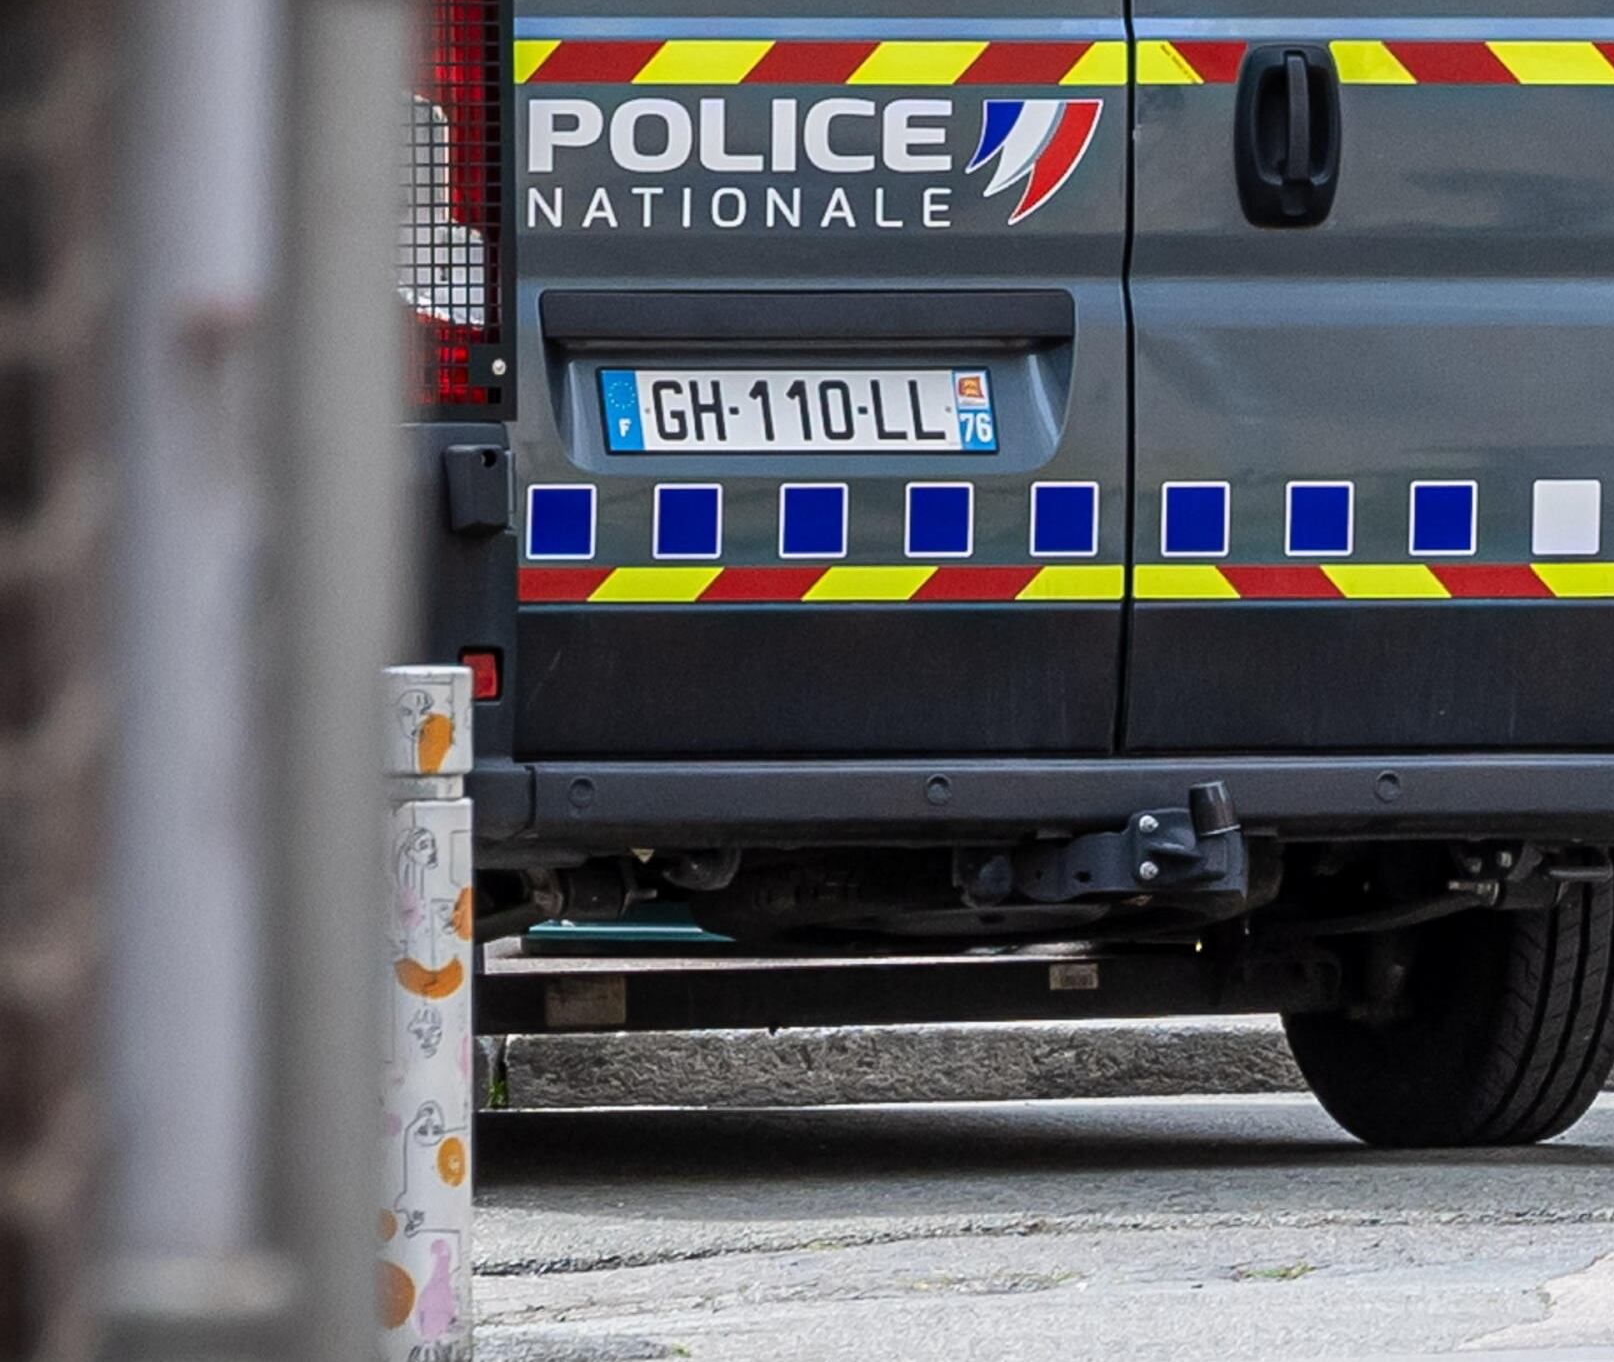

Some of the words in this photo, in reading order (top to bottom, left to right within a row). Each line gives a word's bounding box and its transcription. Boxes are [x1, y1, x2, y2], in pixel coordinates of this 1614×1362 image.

[527, 98, 953, 173] POLICE
[527, 187, 953, 228] NATIONALE
[618, 418, 632, 437] F
[651, 379, 947, 442] GH-110-LL
[959, 412, 993, 444] 76
